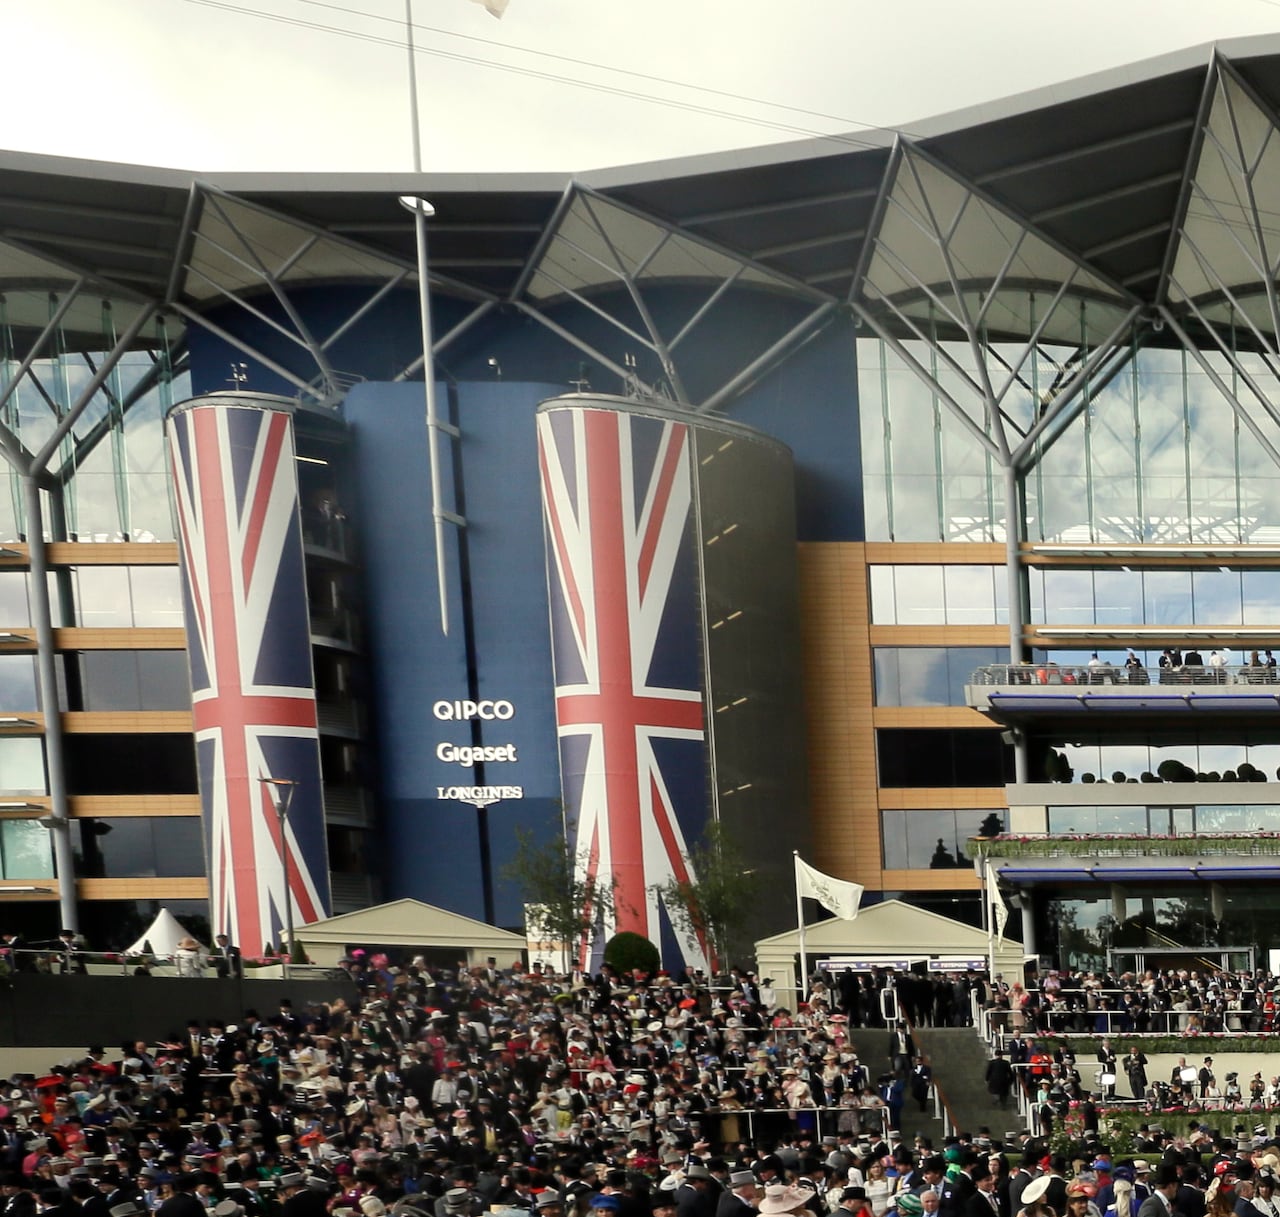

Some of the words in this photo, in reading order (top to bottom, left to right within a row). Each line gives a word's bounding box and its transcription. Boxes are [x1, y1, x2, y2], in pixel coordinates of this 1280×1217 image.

[433, 700, 514, 721] QIPCO
[436, 742, 518, 768] Gigaset
[437, 786, 523, 800] LONGINES
